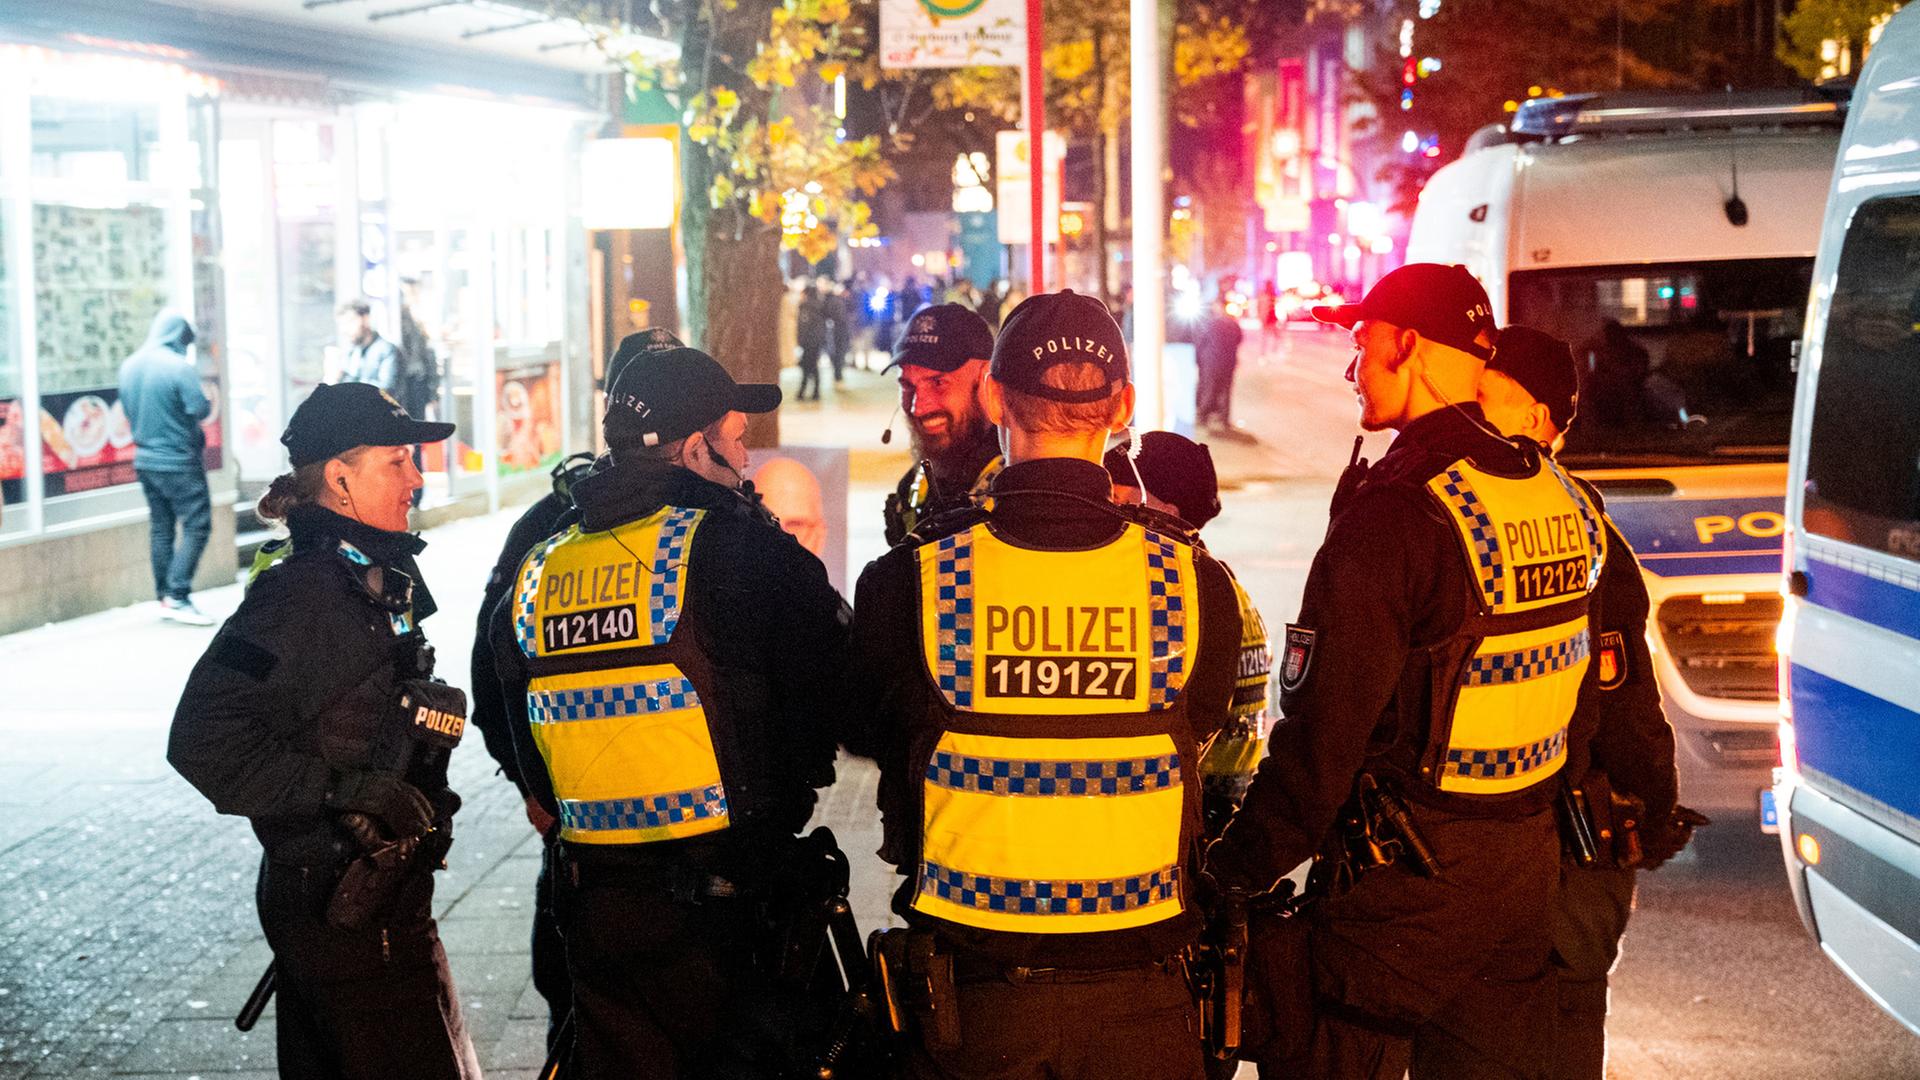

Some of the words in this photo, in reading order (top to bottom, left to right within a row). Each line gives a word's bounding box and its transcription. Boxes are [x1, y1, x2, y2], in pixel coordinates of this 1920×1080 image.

[1032, 336, 1114, 363] POLIZEI
[1503, 512, 1584, 561] POLIZEI
[544, 561, 641, 611] POLIZEI
[1519, 559, 1587, 599] 112123
[545, 608, 634, 648] 112140
[987, 605, 1137, 652] POLIZEI
[992, 659, 1134, 696] 119127
[415, 706, 465, 737] POLIZEI
